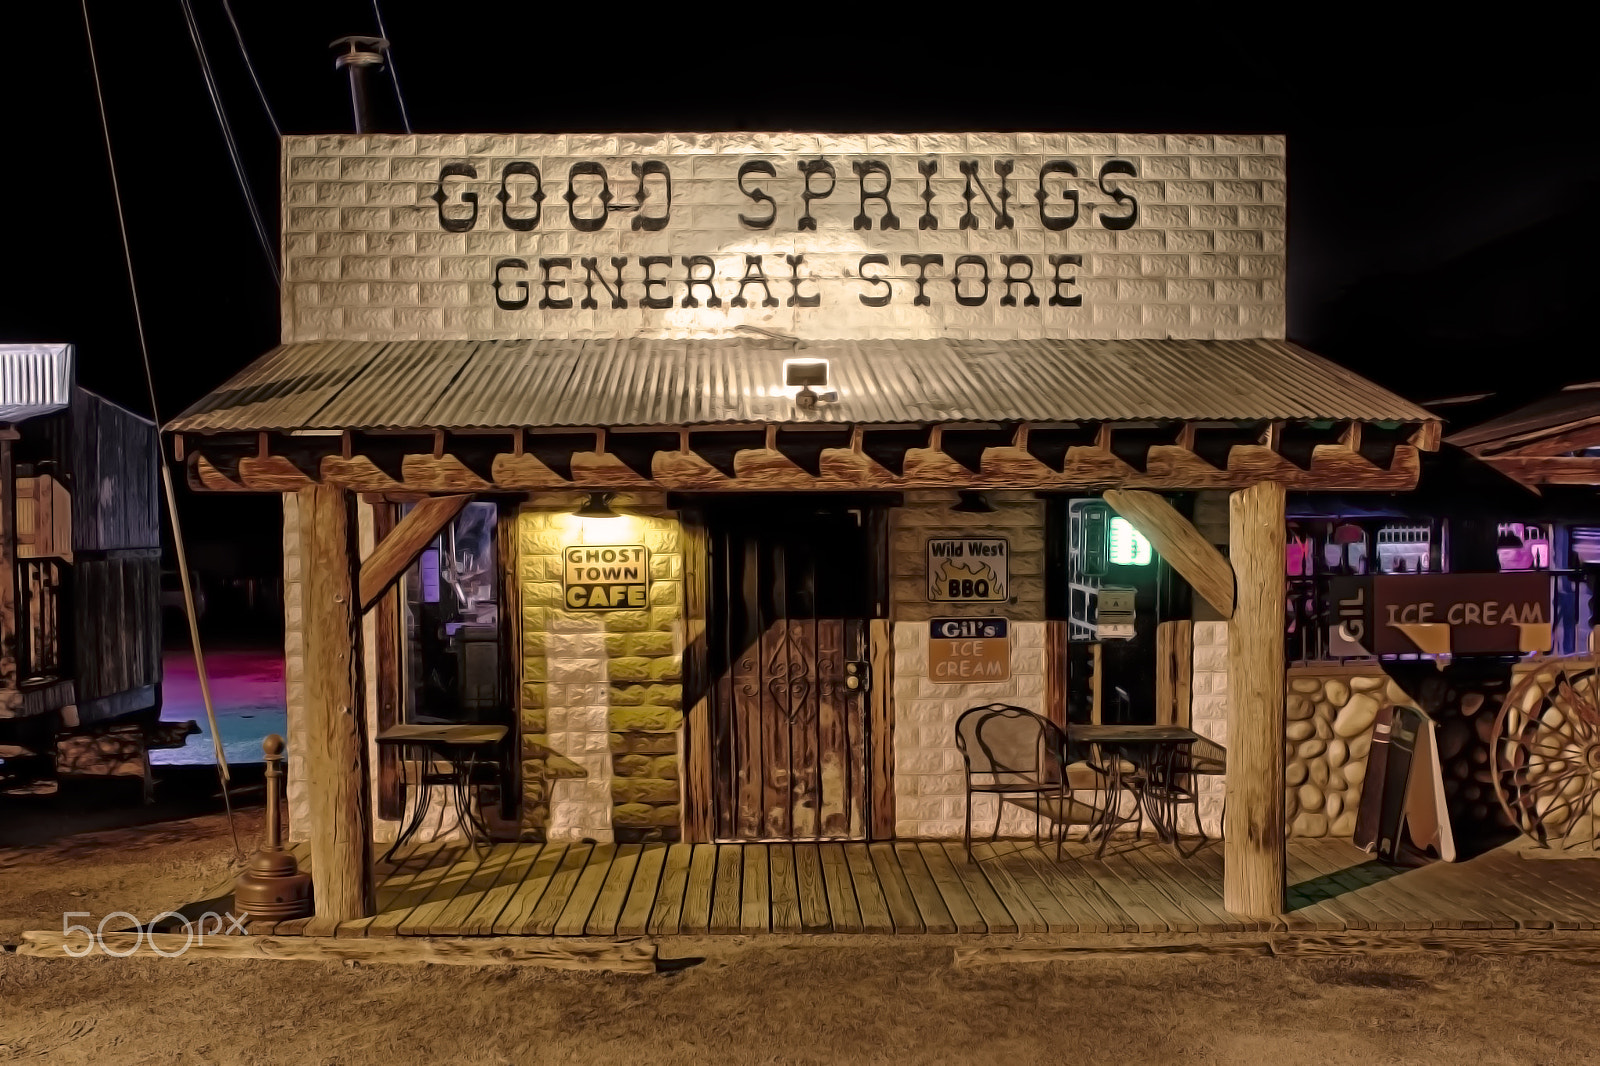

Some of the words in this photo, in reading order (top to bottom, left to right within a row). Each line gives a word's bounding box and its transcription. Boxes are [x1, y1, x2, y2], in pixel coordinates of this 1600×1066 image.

[432, 161, 671, 232] GOOD
[738, 160, 1138, 231] SPRINGS
[491, 255, 820, 310] GENERAL
[859, 254, 1083, 307] STORE
[568, 549, 643, 563] GHOST
[931, 541, 964, 558] Wild
[968, 541, 1004, 557] West
[574, 567, 638, 581] TOWN
[566, 585, 646, 608] CAFE
[948, 579, 990, 598] BBQ
[1338, 588, 1364, 643] GIL
[1385, 603, 1435, 625] ICE
[1447, 601, 1544, 626] CREAM
[941, 621, 996, 638] Gil's
[950, 640, 984, 657] ICE
[935, 660, 1002, 677] CREAM
